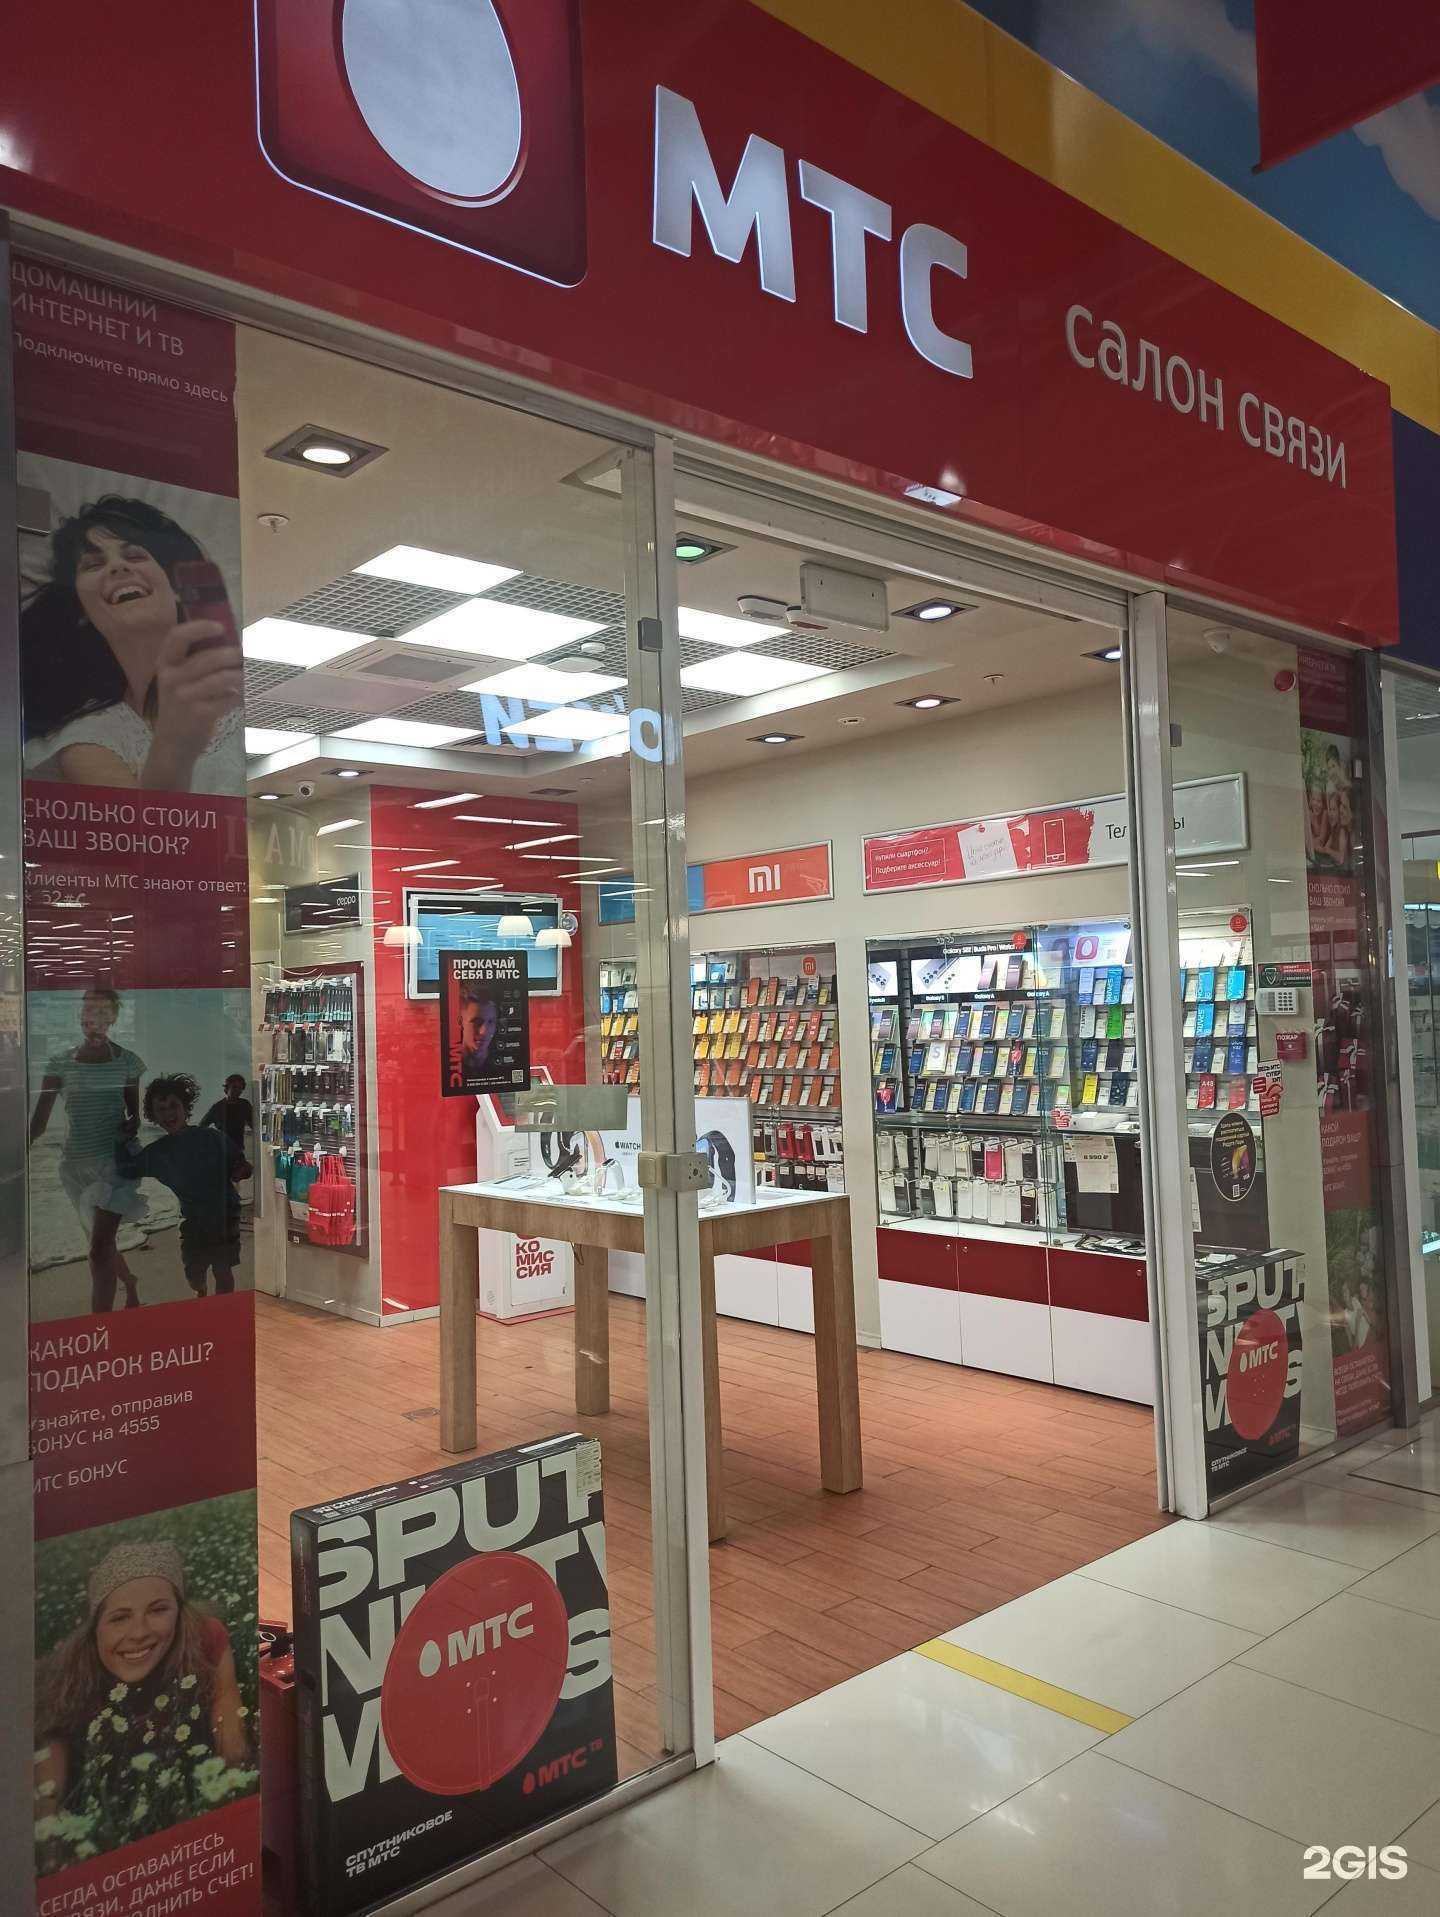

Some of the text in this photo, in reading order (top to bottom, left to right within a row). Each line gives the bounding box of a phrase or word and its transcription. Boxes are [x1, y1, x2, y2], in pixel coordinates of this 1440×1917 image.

[653, 84, 973, 379] МТС
[136, 326, 152, 349] И
[158, 332, 184, 357] ТВ
[127, 366, 180, 391] прямо
[183, 382, 228, 402] здесь
[1065, 305, 1348, 489] салон связи
[24, 797, 217, 830] СКОЛЬКО СТОИЛ
[85, 831, 190, 855] ЗВОНОК?
[105, 874, 139, 889] МТС
[144, 878, 194, 892] знают
[198, 879, 246, 894] ответ:
[453, 956, 515, 969] ПРОКАЧАЙ
[453, 969, 520, 980] СЕБЯ В МТС
[620, 1142, 641, 1150] WATCH
[516, 1239, 540, 1255] КО
[516, 1250, 554, 1267] МИС
[516, 1264, 552, 1280] СИЯ
[150, 1341, 214, 1373] ВАШ?
[1249, 1340, 1278, 1370] МТС
[111, 1390, 193, 1418] отправив
[92, 1426, 114, 1443] на
[119, 1415, 160, 1437] 4555
[68, 1459, 128, 1487] БОНУС
[448, 1602, 534, 1668] МТС
[538, 1746, 588, 1789] МТС
[345, 1810, 453, 1867] СПУТНИКОВОЕ
[36, 1833, 224, 1917] СЕГДА ОСТАВАЙТЕСЬ
[128, 1870, 184, 1907] ДАЖЕ
[189, 1848, 235, 1881] ЕСЛИ
[346, 1846, 400, 1878] ТВ МТС
[207, 1862, 254, 1895] СЧЕТ!
